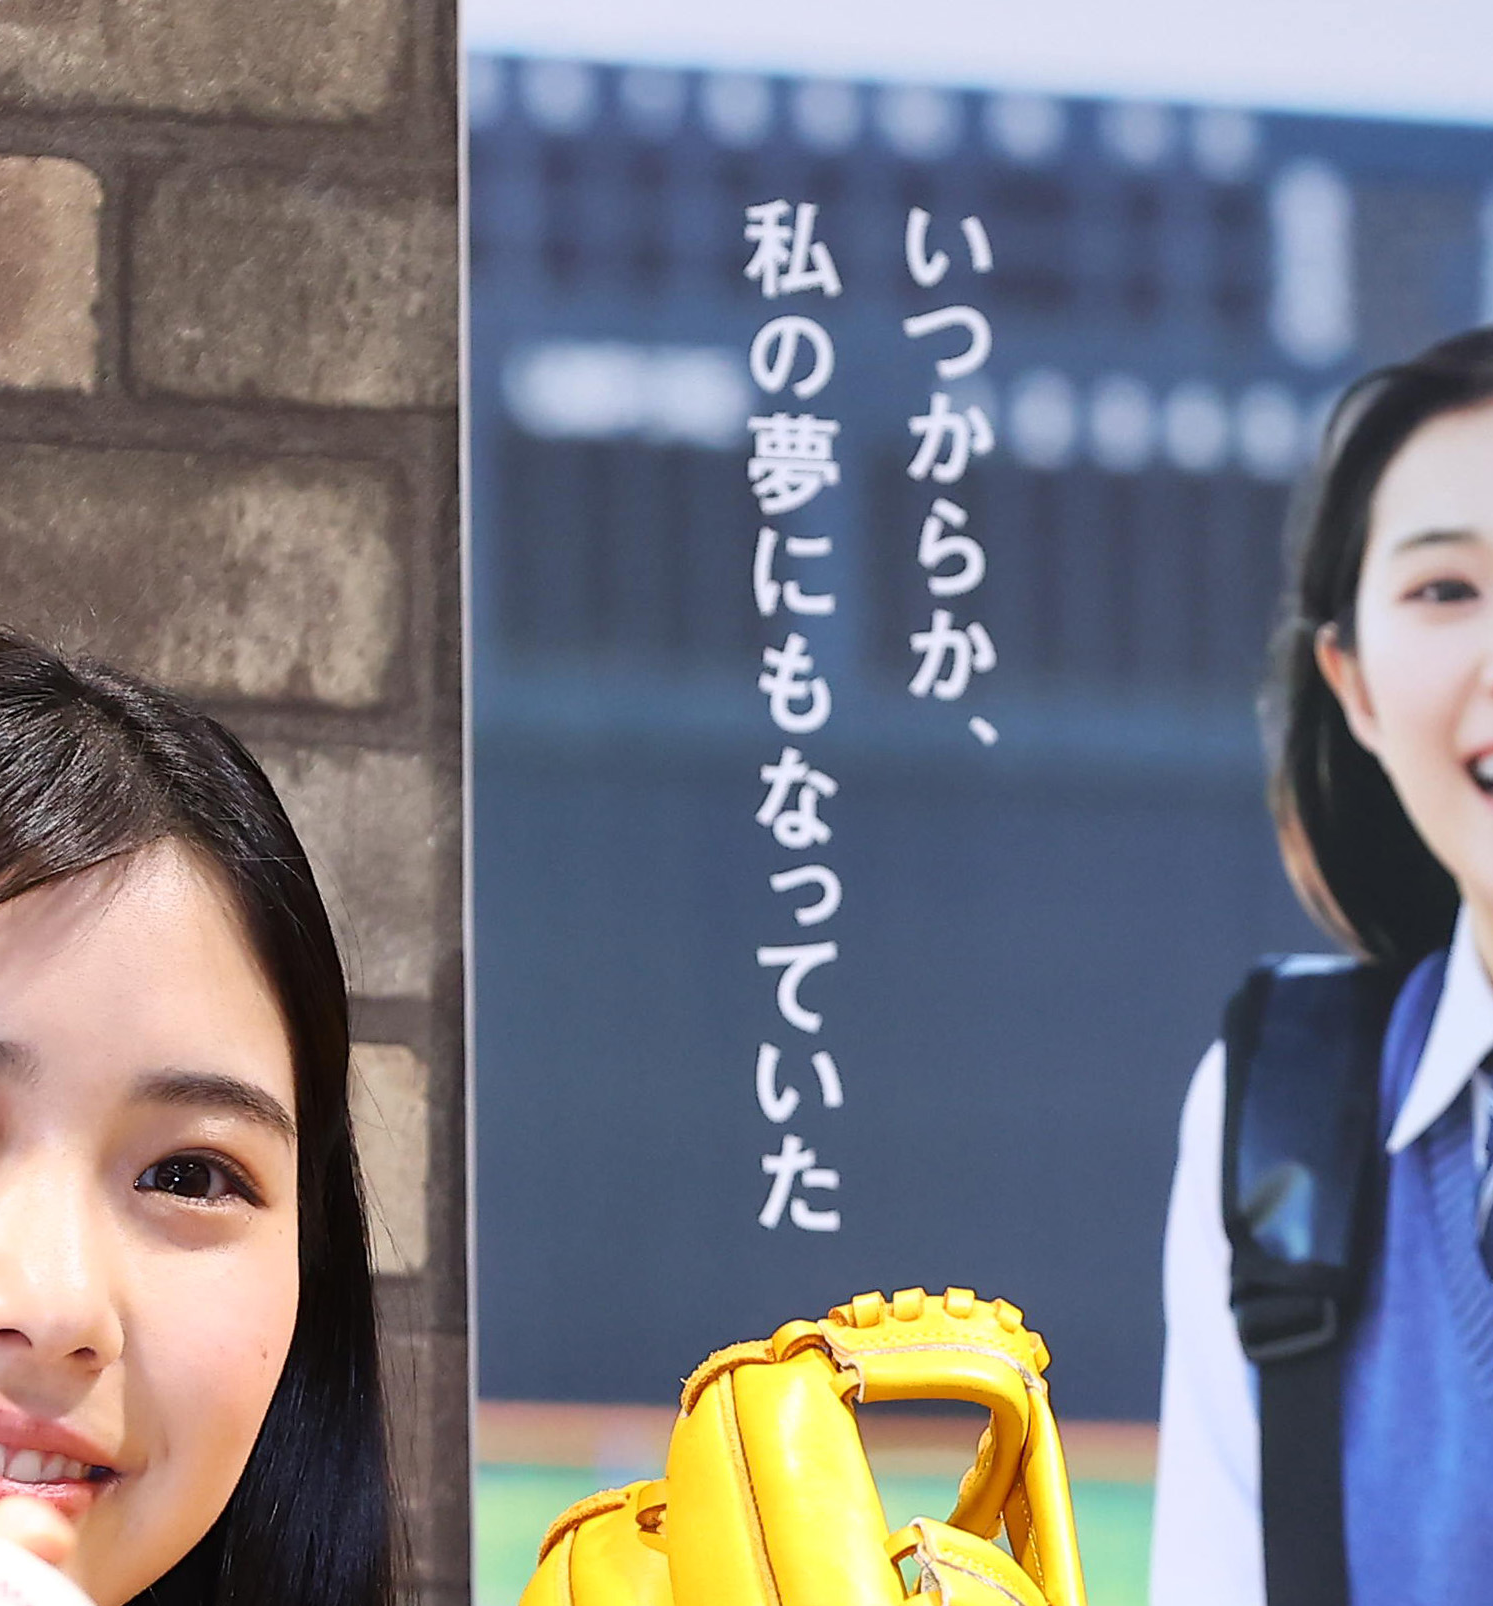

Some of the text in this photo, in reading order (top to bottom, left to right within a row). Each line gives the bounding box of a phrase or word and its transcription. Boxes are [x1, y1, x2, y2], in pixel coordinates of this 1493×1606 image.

[743, 198, 844, 1233] 私の夢にもなっていた
[904, 207, 999, 747] いつからか、
